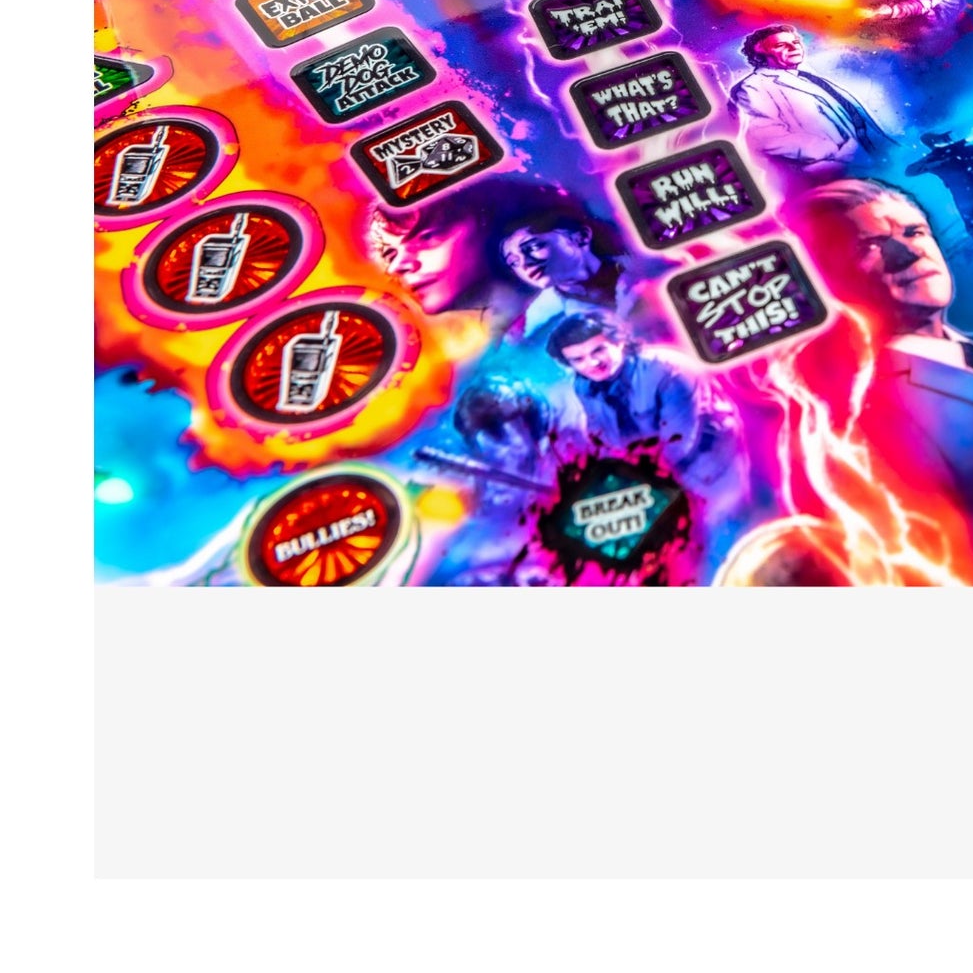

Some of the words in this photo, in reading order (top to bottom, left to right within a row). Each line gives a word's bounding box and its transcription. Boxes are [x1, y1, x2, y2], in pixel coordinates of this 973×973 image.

[313, 43, 388, 92] DEMO
[335, 67, 420, 112] ATTACK
[337, 58, 395, 96] DOG
[591, 70, 674, 107] WHAT'S
[606, 94, 679, 127] THAT?
[371, 113, 455, 161] MYSTERY
[651, 162, 716, 202] RUN
[654, 183, 739, 229] WILL!
[687, 255, 778, 304] CAN'T
[696, 273, 792, 329] STOP
[713, 296, 800, 345] THIS!
[576, 488, 650, 521] BREAK
[274, 508, 377, 564] BULLIES!
[588, 513, 643, 542] OUT!
